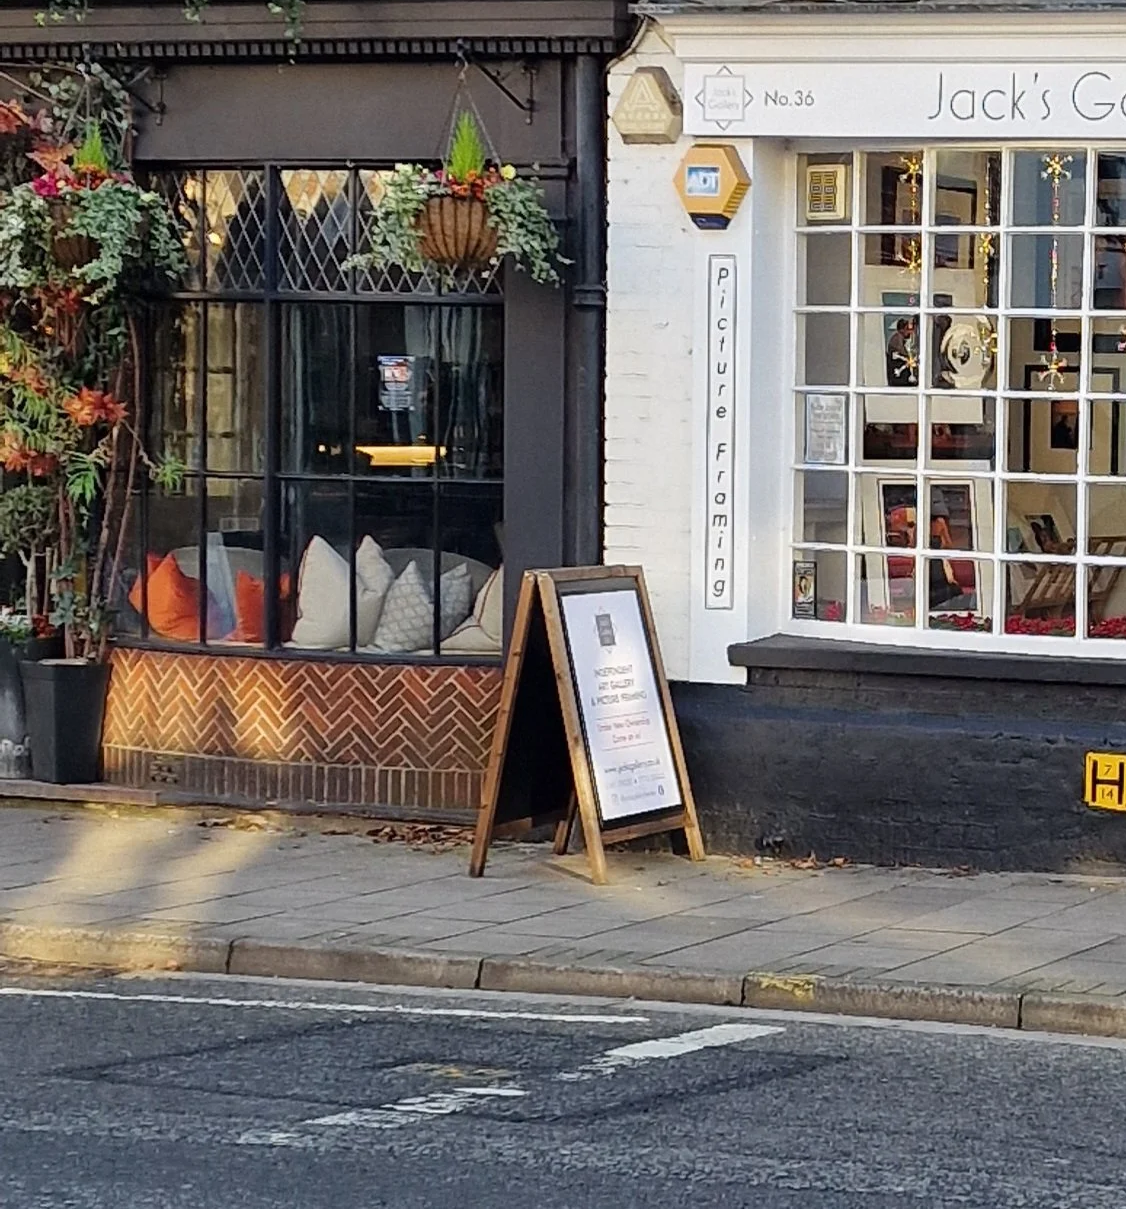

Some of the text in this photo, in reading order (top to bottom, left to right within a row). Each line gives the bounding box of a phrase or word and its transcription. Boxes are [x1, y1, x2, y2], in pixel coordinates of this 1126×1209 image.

[764, 90, 815, 106] No.36
[928, 71, 1050, 120] Jack's
[712, 267, 729, 598] Picture Framing
[1091, 760, 1125, 805] H
[1103, 764, 1113, 776] 7
[1101, 788, 1114, 800] 14
